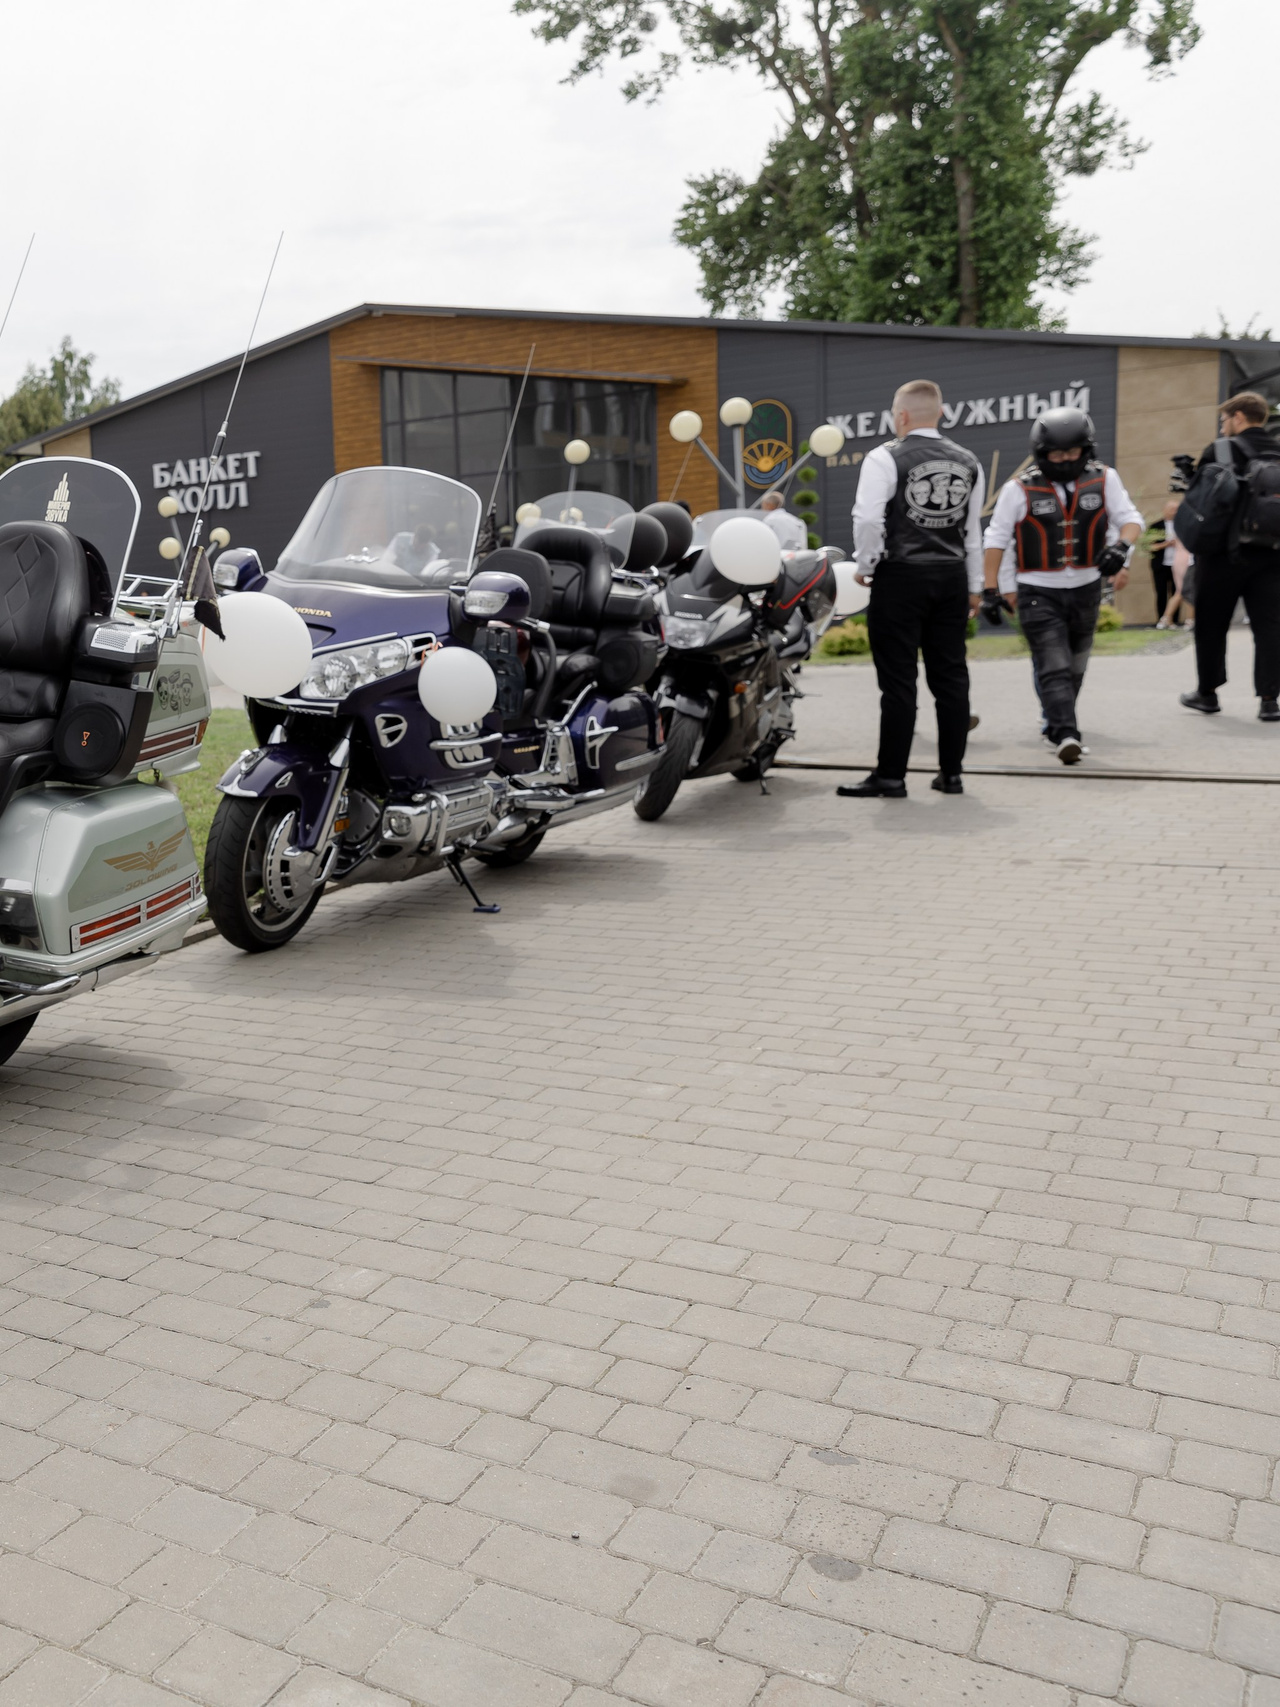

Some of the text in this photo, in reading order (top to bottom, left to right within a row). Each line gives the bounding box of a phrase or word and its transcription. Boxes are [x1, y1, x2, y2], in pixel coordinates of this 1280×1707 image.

[826, 379, 1091, 439] ЖЕМУЖНЫЙ
[152, 451, 261, 488] БАНКЕТ
[168, 481, 249, 514] ХОЛЛ
[293, 606, 333, 618] HONDA
[673, 610, 704, 620] HONDA
